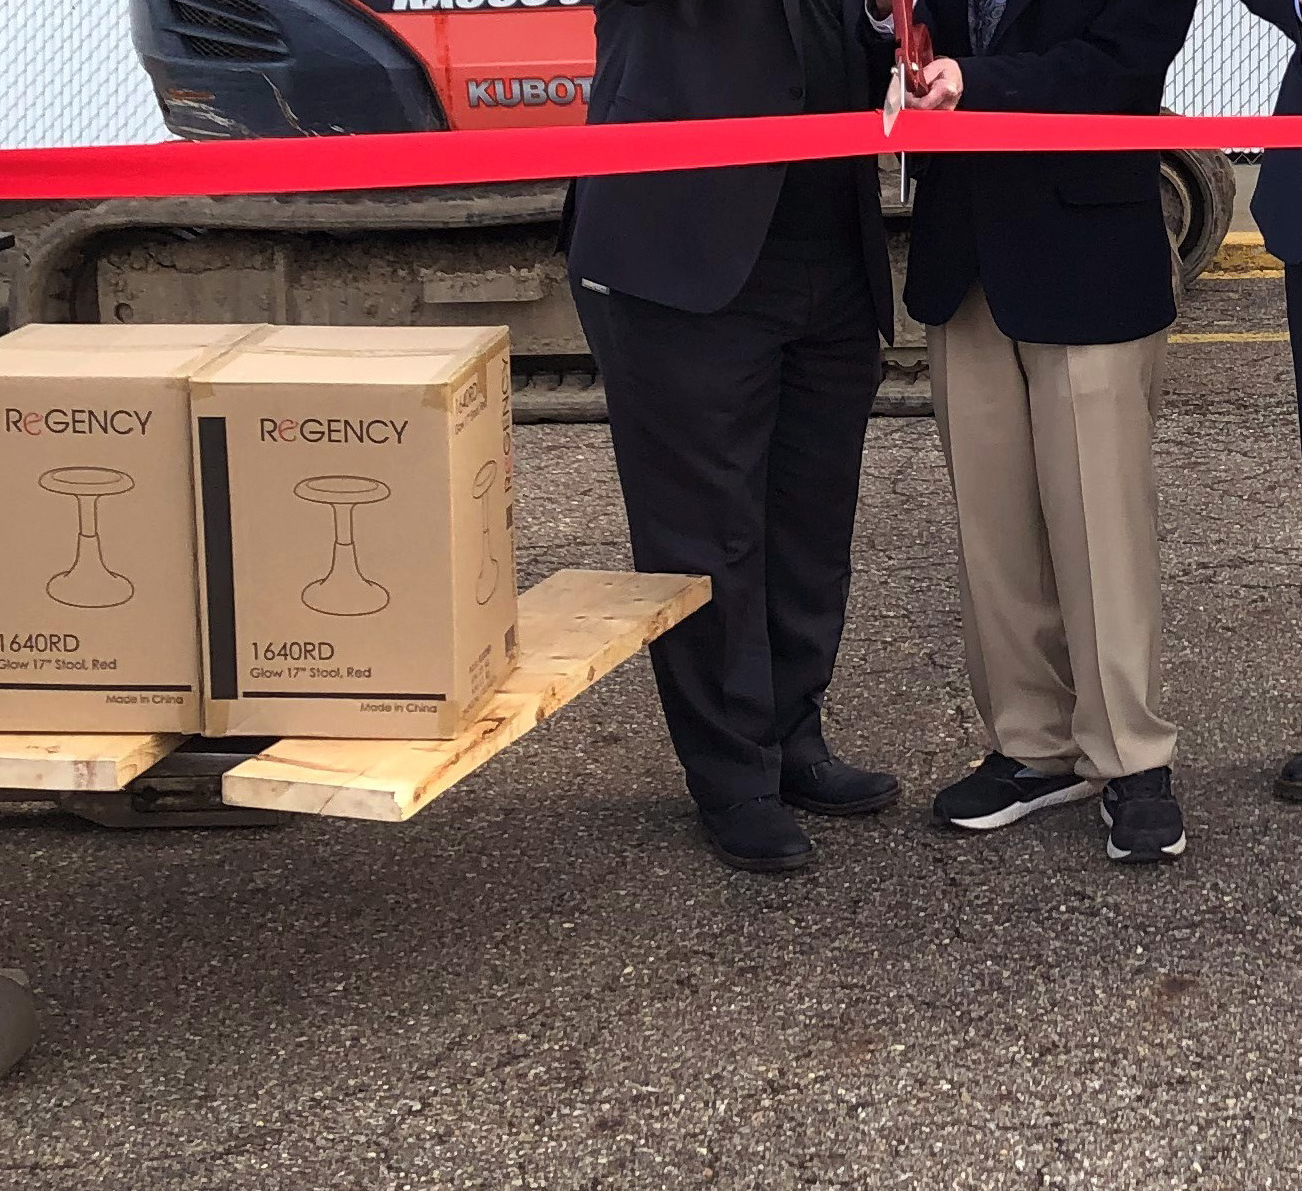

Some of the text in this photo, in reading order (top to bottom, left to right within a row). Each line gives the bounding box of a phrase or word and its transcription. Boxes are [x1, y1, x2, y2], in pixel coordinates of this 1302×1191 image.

[466, 76, 594, 109] KUBOT
[251, 641, 335, 661] 1640RD
[91, 659, 117, 671] Red
[250, 667, 283, 679] Glow
[309, 667, 343, 680] Stool,
[346, 667, 372, 679] Red
[105, 694, 184, 705] Made in China
[360, 702, 438, 714] Made in China
